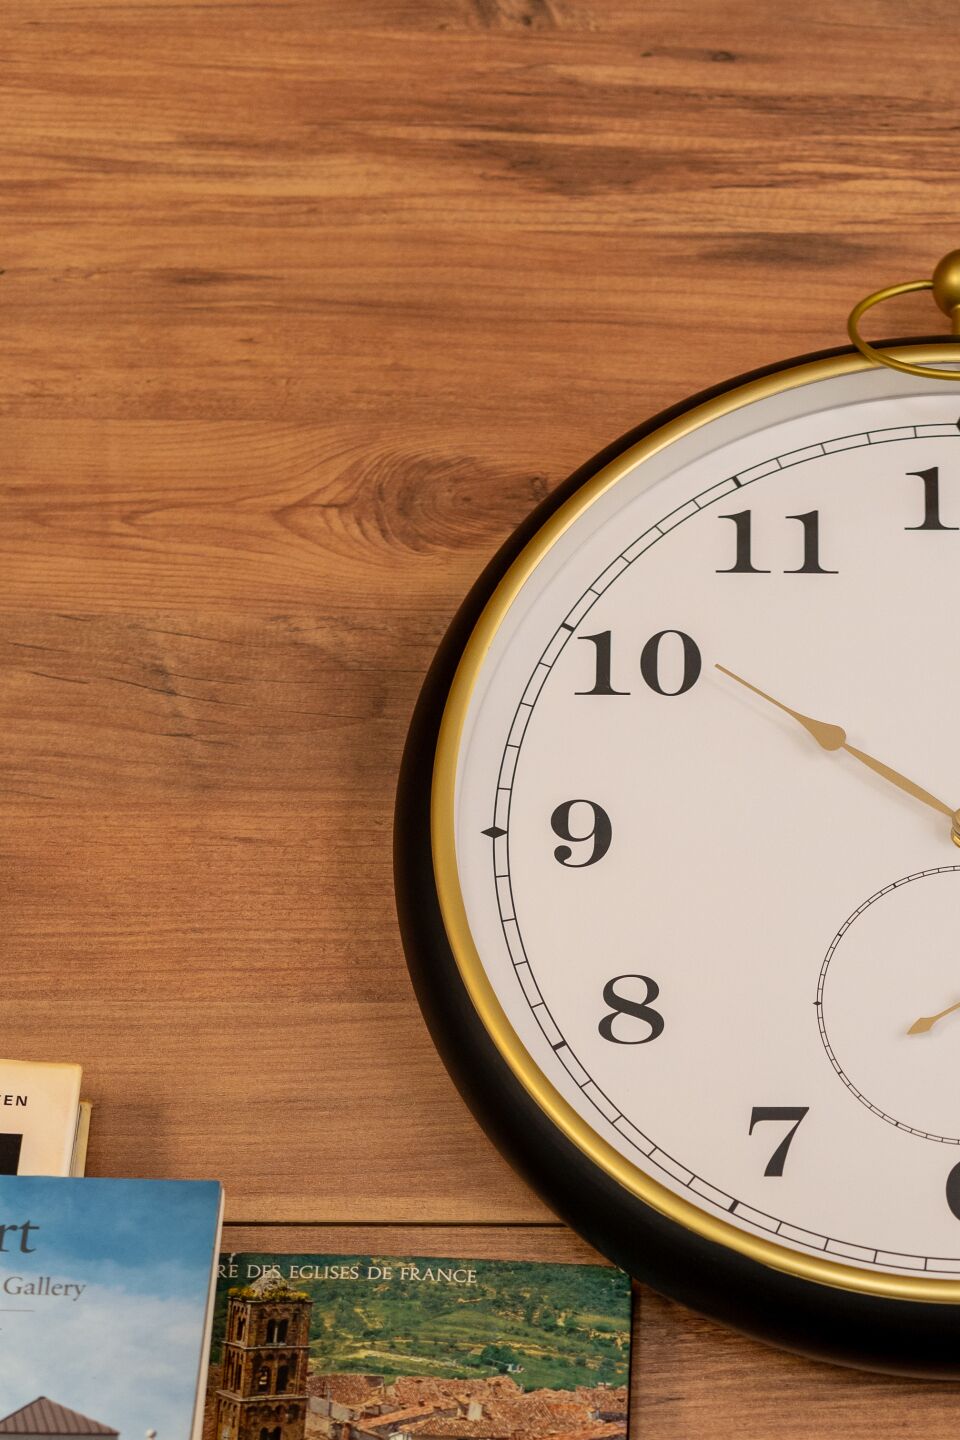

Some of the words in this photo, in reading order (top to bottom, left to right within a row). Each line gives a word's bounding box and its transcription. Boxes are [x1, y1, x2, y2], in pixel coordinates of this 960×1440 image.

[715, 510, 839, 574] 11
[573, 629, 702, 697] 10
[550, 799, 613, 868] 9
[598, 974, 666, 1045] 8
[0, 1094, 28, 1107] EN
[748, 1106, 810, 1177] 7
[3, 1276, 86, 1302] Gallery
[290, 1265, 359, 1280] EGLISES
[368, 1266, 392, 1280] DE
[401, 1267, 477, 1284] FRANCE
